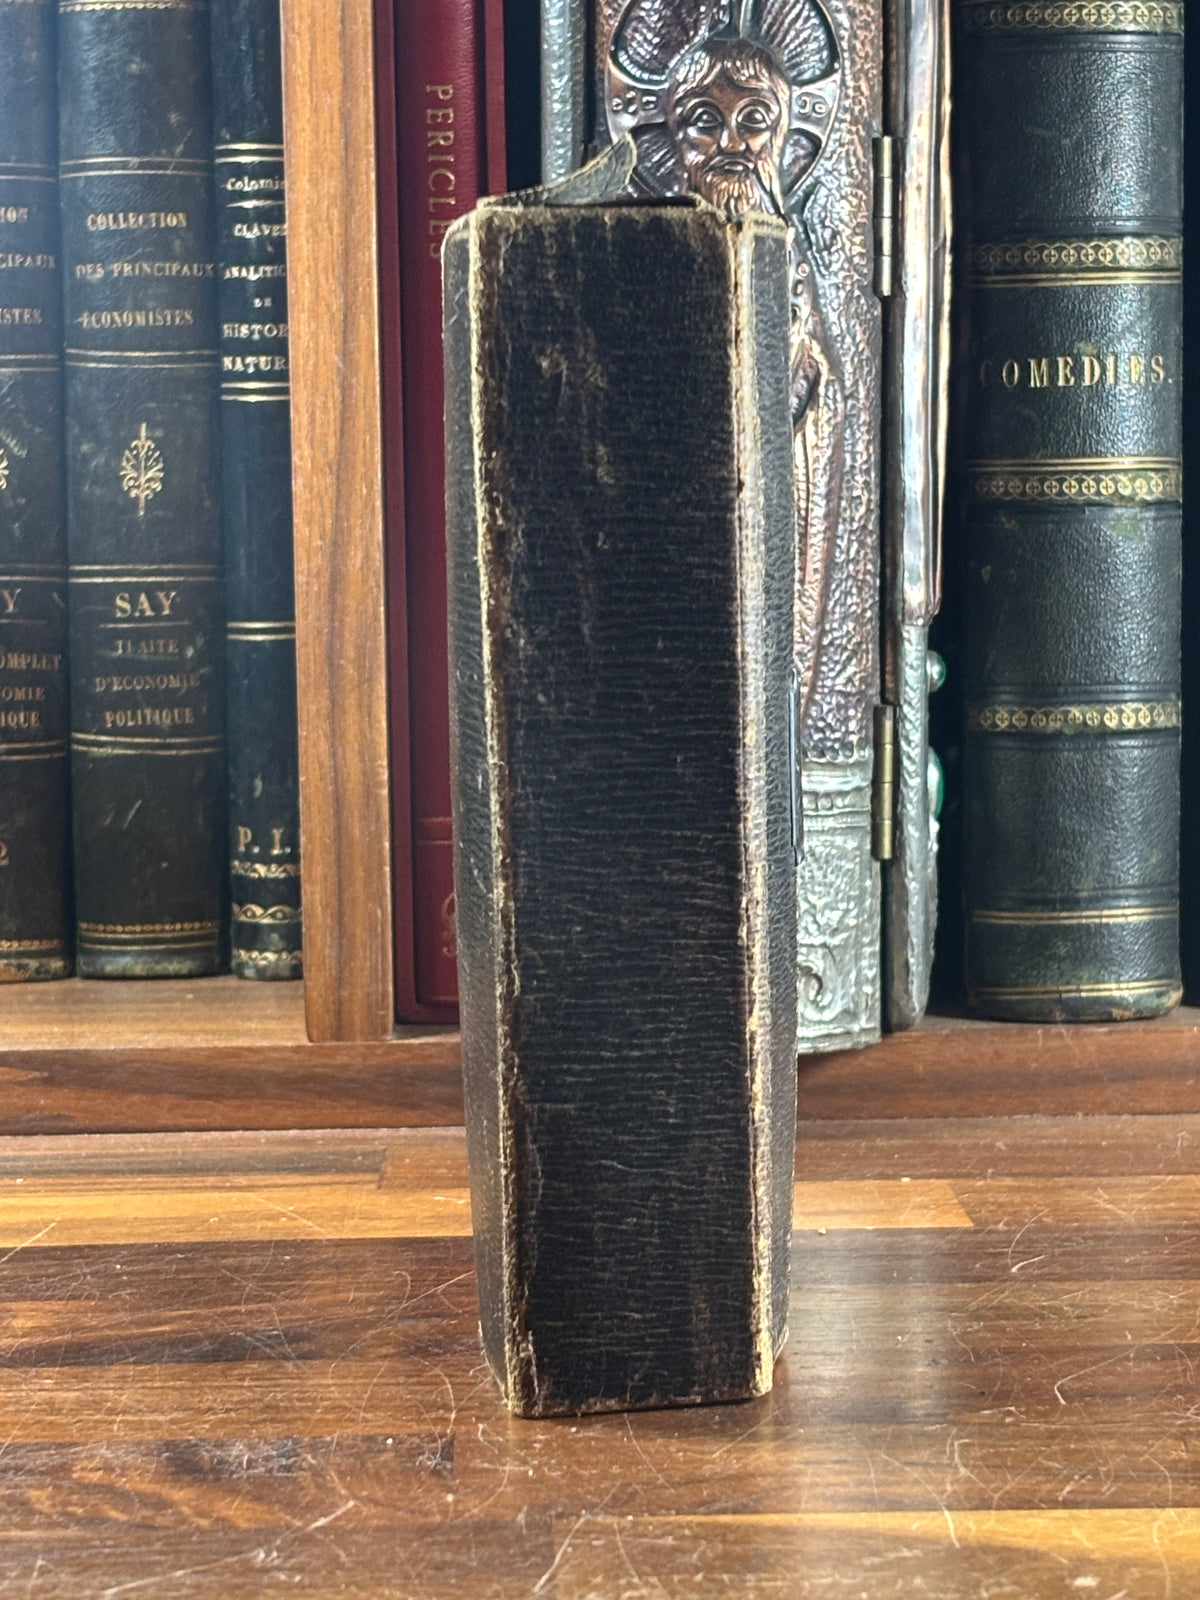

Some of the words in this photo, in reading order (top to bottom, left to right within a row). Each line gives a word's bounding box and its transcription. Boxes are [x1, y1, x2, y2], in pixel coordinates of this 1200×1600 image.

[86, 212, 188, 231] COLLECTION
[76, 263, 104, 279] DES
[113, 262, 214, 277] PRINCIPAUX
[980, 355, 1173, 389] COMEDIES.
[115, 591, 177, 618] SAY
[105, 708, 195, 728] POLITIQUE
